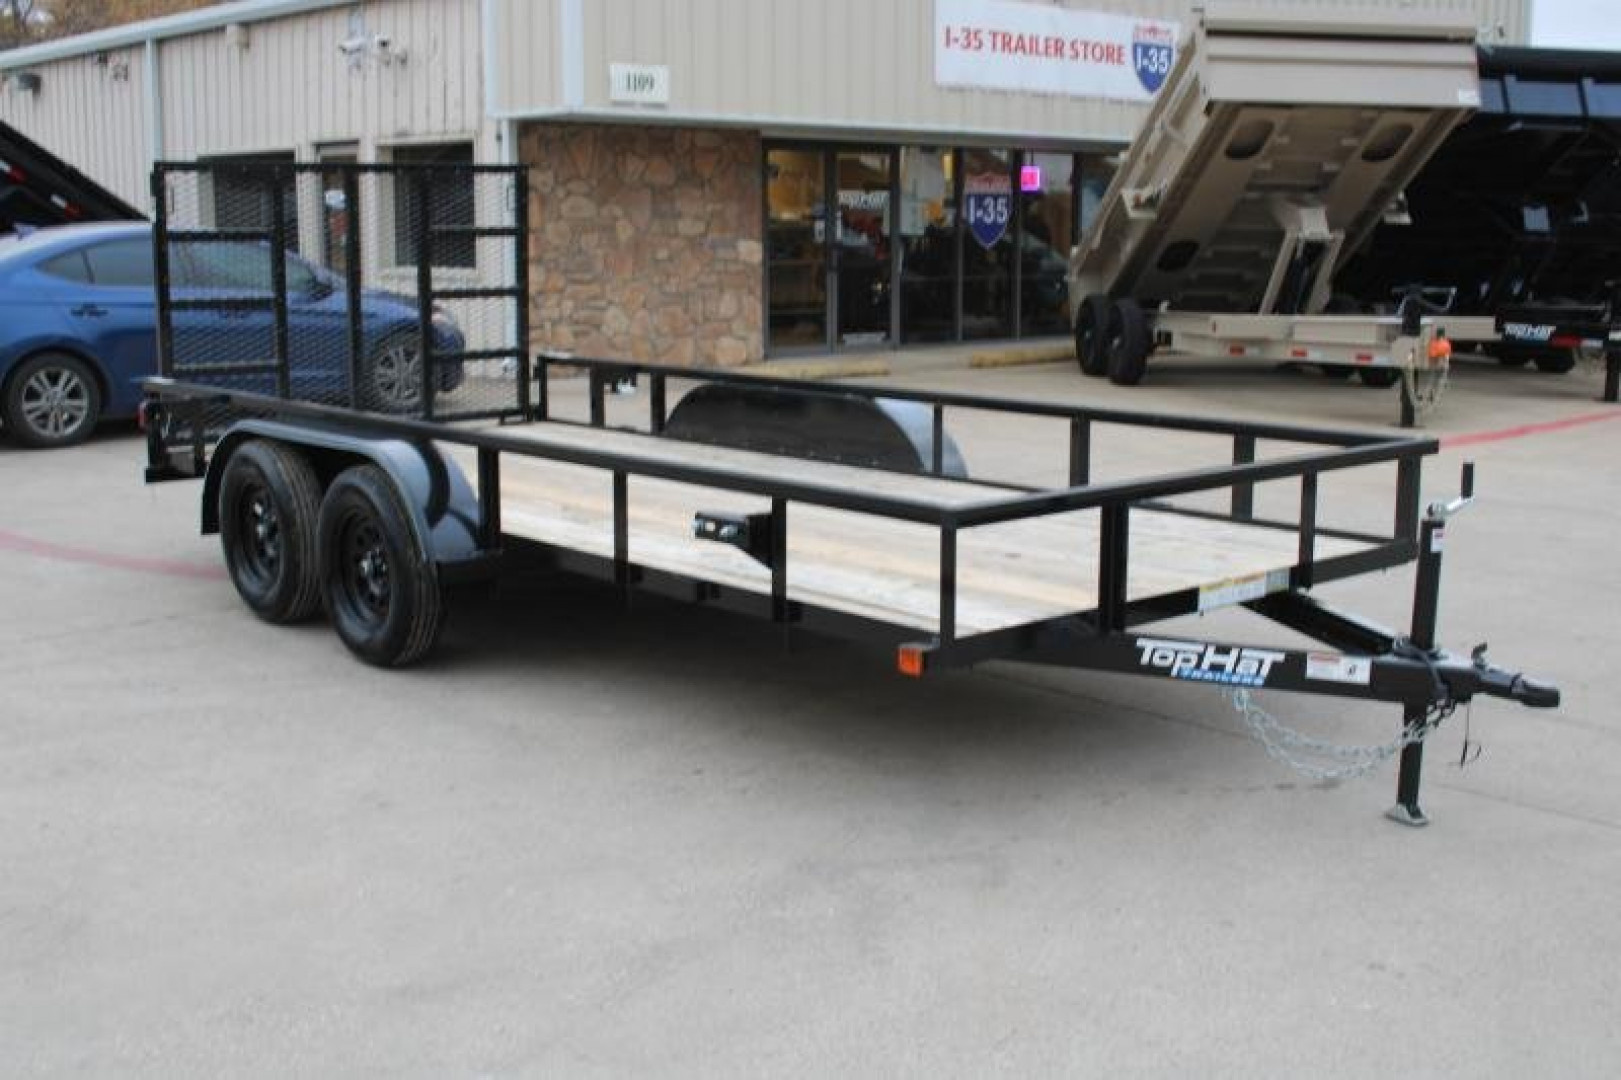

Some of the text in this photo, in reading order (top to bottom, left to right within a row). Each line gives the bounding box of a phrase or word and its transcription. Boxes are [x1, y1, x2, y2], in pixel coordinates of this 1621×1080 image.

[944, 26, 1126, 66] I-35 TRAILER STORE
[1135, 45, 1168, 74] I-35
[969, 195, 1008, 224] I-35
